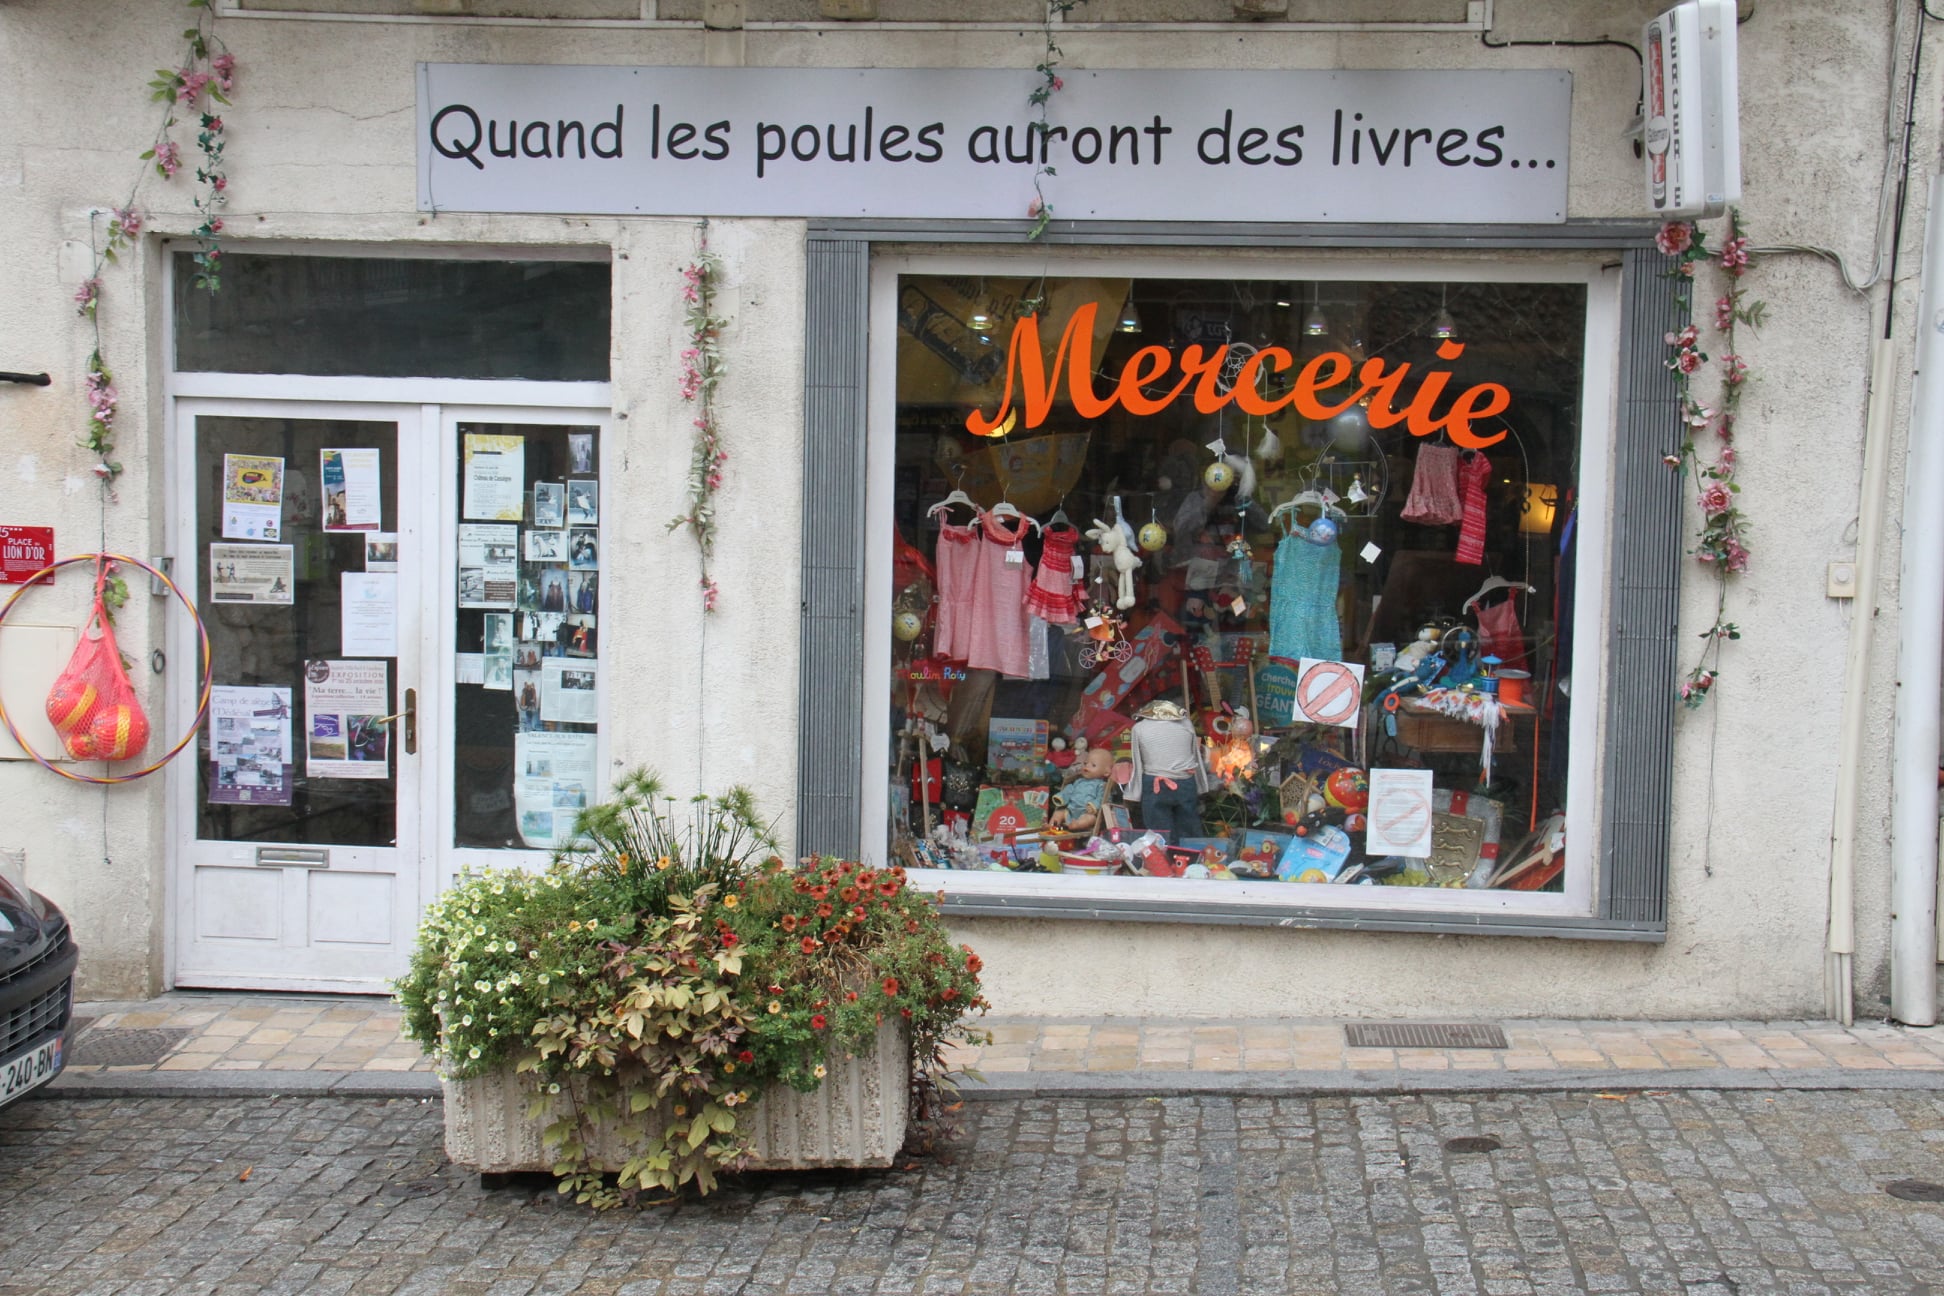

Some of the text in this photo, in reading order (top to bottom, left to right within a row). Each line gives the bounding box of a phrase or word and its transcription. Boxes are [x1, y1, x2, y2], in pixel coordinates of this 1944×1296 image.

[1668, 10, 1681, 208] MERCERIE
[430, 103, 1556, 179] Quand les poules auront des livres...
[965, 302, 1511, 449] Mercerie
[8, 537, 33, 546] PLACE
[3, 545, 46, 560] LION D'OR
[943, 666, 966, 682] Roty
[212, 695, 236, 706] Camp
[999, 816, 1016, 825] 20
[0, 1042, 55, 1096] -240-BN
